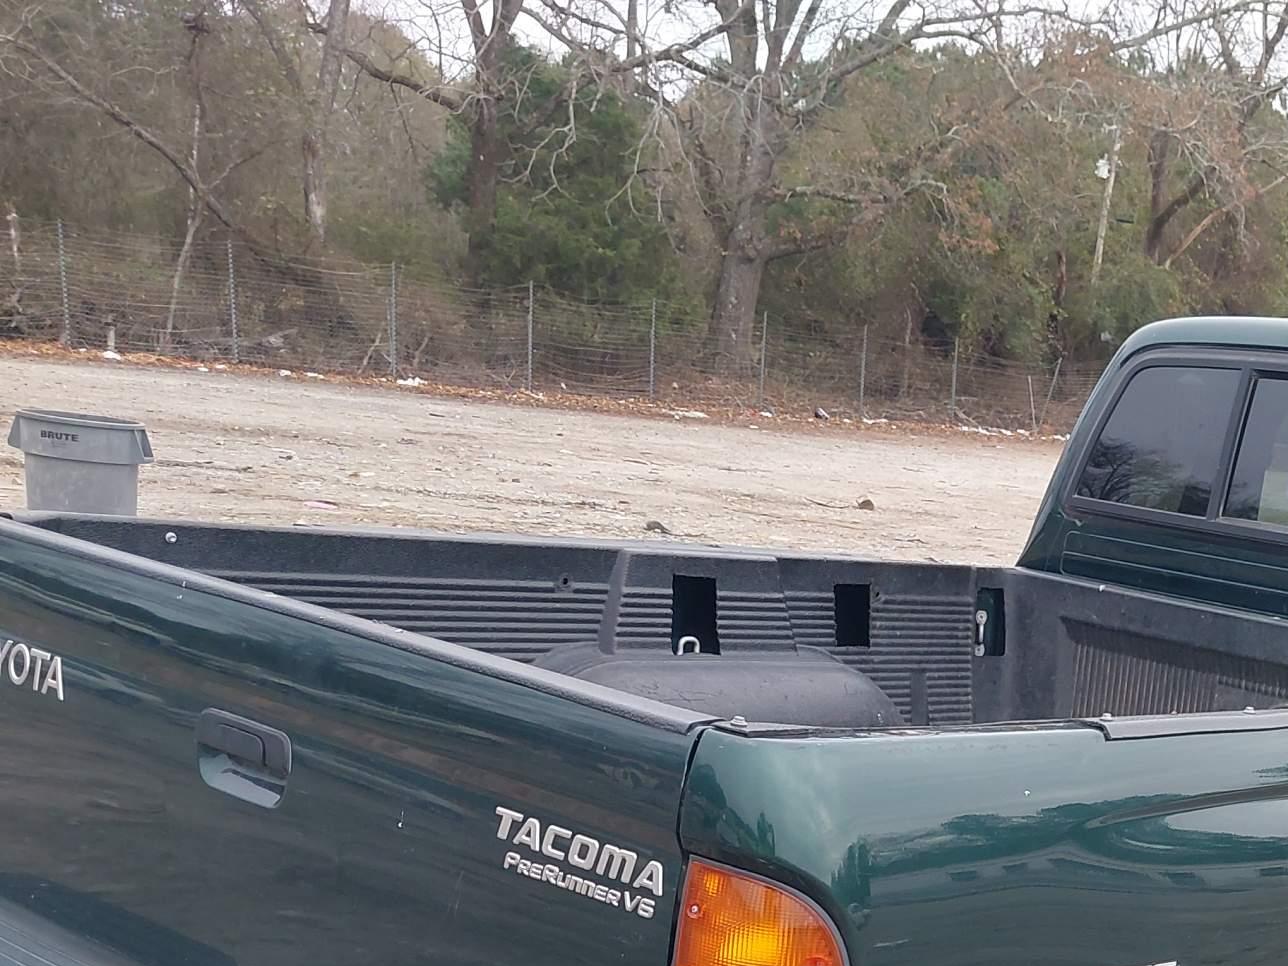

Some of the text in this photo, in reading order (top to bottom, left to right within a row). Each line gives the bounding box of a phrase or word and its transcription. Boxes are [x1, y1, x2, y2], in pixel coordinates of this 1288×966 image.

[40, 429, 80, 442] BRUTE
[495, 806, 664, 897] TACOMA
[623, 890, 656, 919] V6
